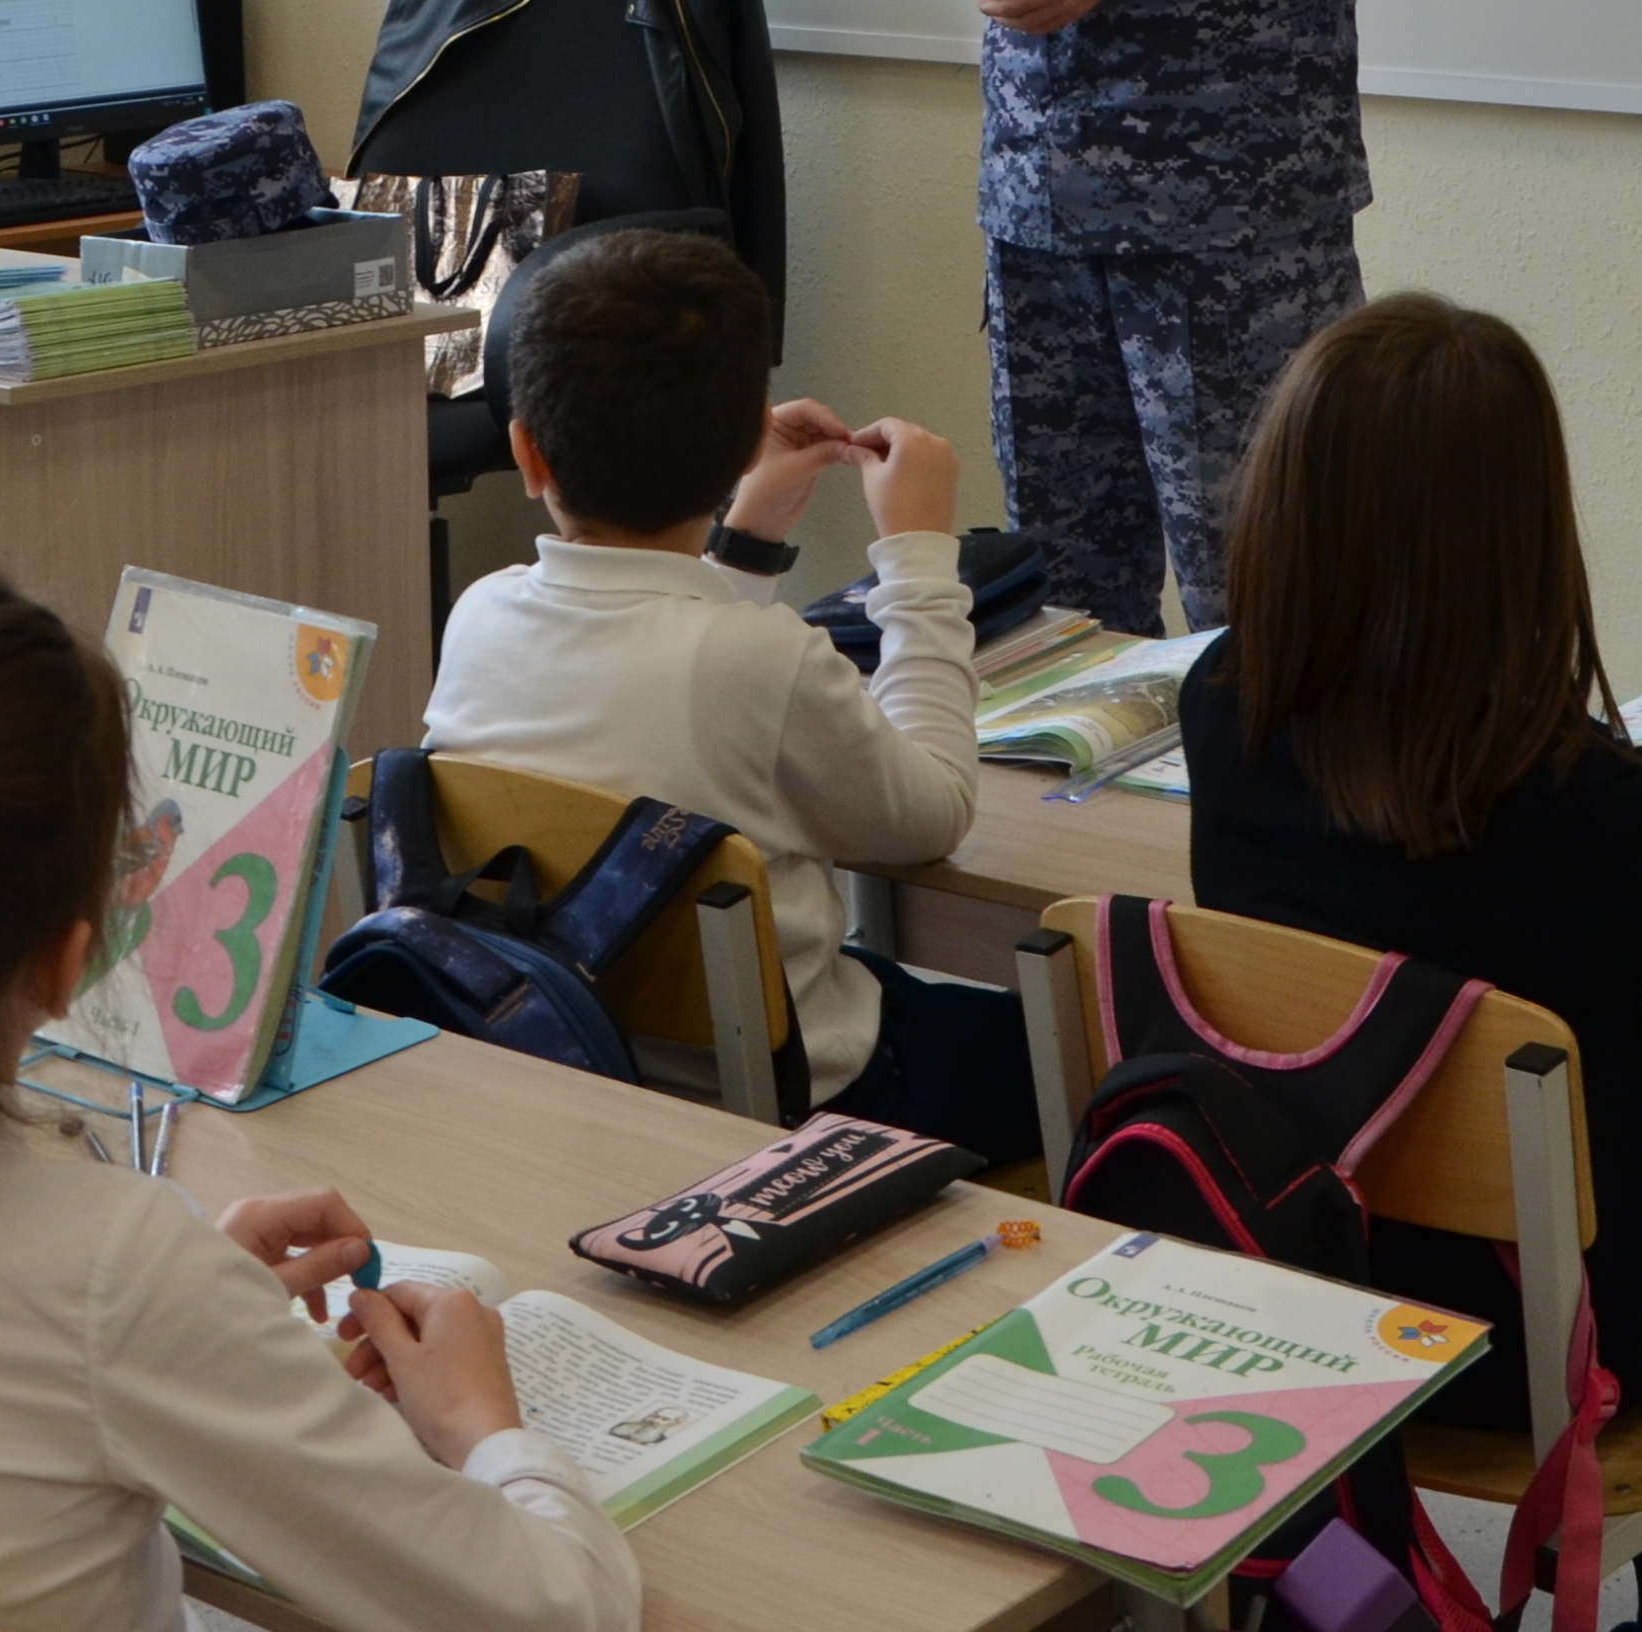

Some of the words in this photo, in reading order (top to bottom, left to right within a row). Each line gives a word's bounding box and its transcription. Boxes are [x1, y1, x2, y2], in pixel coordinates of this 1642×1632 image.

[161, 737, 258, 798] МИР
[173, 852, 277, 1033] 3
[749, 1156, 829, 1206] meow
[819, 1133, 867, 1162] you
[1066, 1276, 1361, 1374] Окружающий
[1120, 1322, 1285, 1378] МИР
[1071, 1344, 1171, 1380] Рабочая
[1089, 1364, 1176, 1394] тетрадь
[1092, 1410, 1307, 1519] 3
